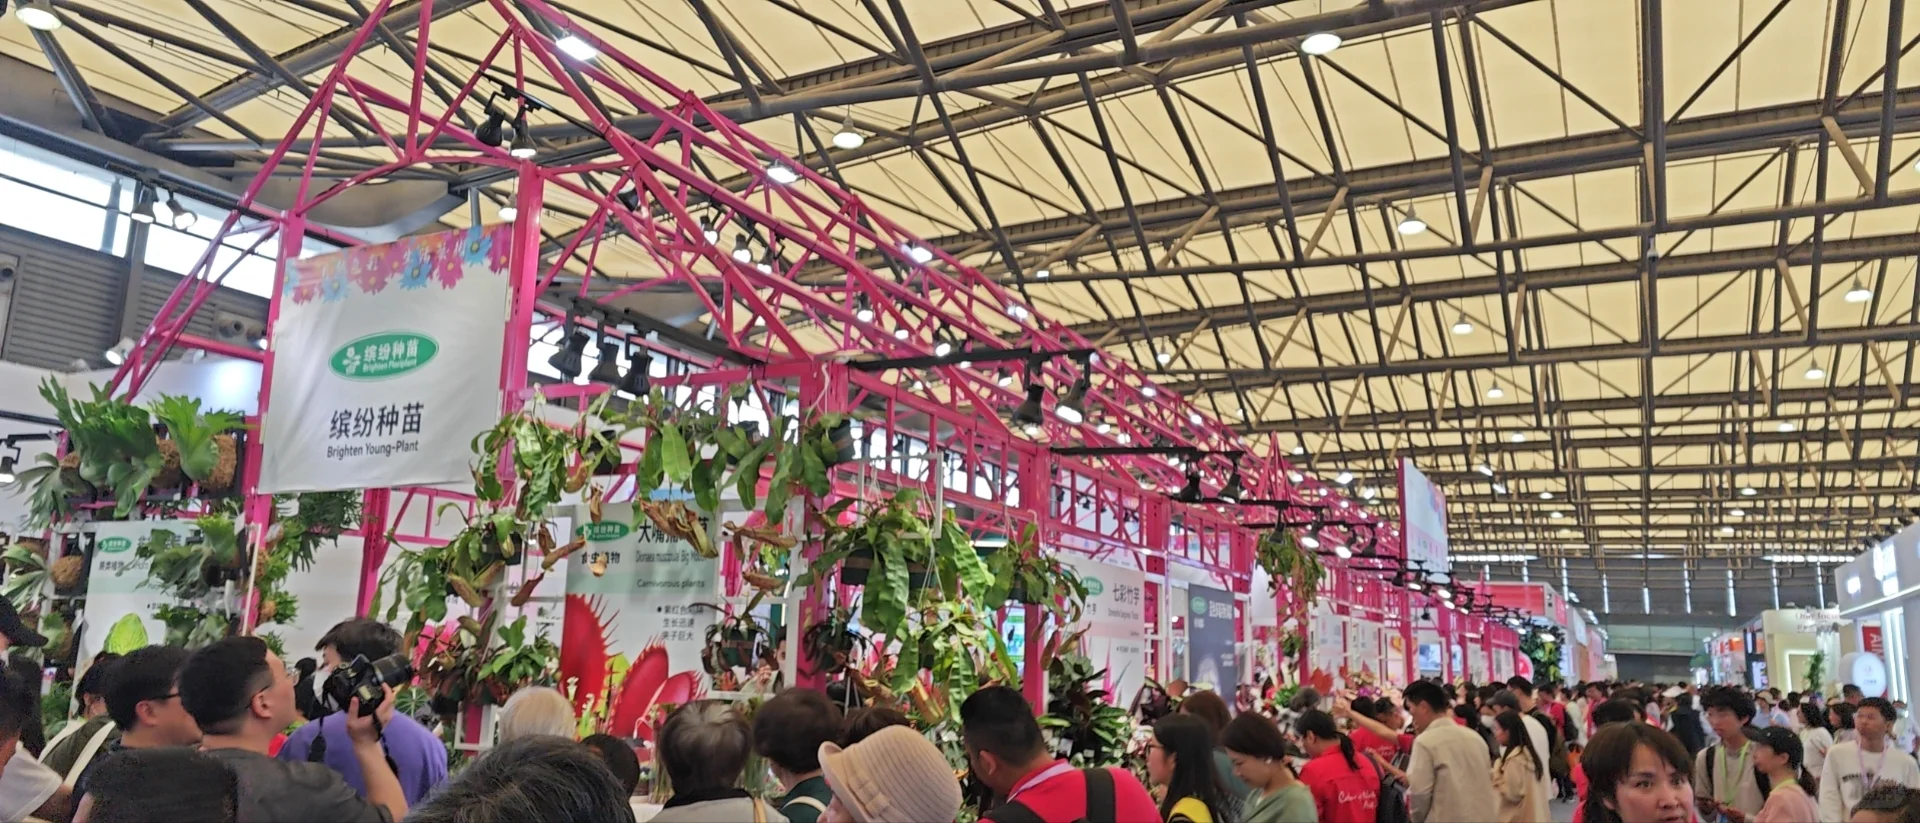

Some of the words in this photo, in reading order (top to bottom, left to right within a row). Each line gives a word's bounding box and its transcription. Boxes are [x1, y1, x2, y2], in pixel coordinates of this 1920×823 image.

[363, 338, 419, 362] 缤纷种苗
[362, 361, 388, 373] Brighten
[329, 401, 424, 440] 缤纷种苗
[327, 444, 363, 461] Brighten
[365, 440, 419, 457] Young-Plant
